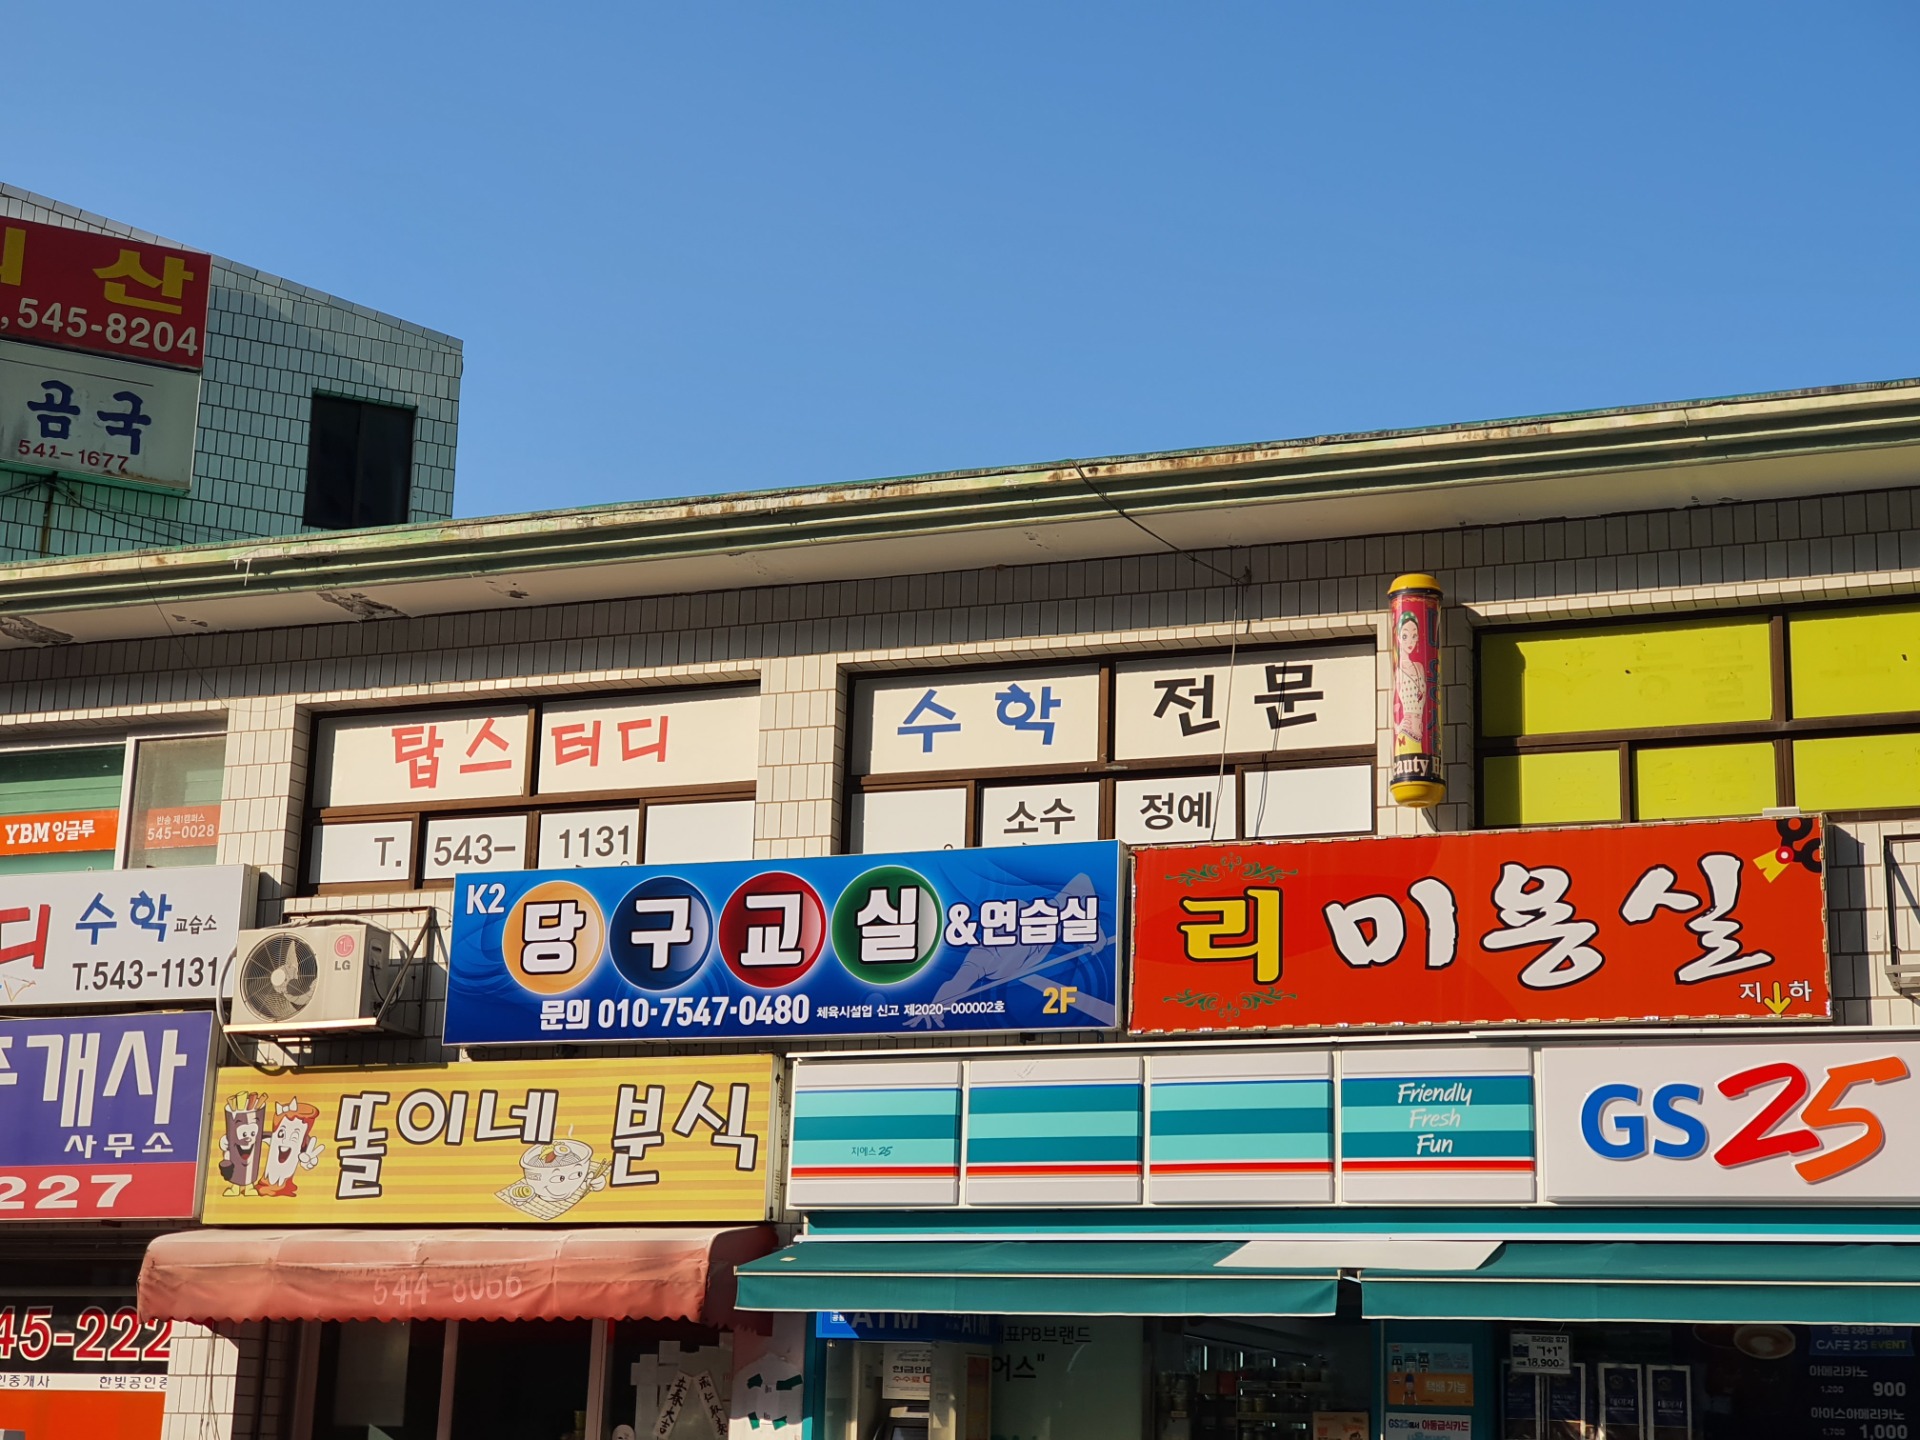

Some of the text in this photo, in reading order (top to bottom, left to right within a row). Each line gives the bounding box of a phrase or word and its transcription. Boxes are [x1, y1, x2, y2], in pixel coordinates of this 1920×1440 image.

[27, 379, 152, 455] 곰국
[897, 664, 1324, 754] 수학 전문
[156, 816, 172, 826] 반송
[1003, 790, 1212, 835] 소수 정예
[147, 824, 216, 841] 545-0028
[374, 836, 403, 868] T.
[558, 825, 631, 858] 1131
[466, 884, 505, 915] K2
[75, 890, 173, 946] 수학
[174, 915, 218, 935] 교습소
[335, 960, 351, 971] LG
[816, 1005, 873, 1019] 체육시설업
[877, 1004, 900, 1017] 신고
[1042, 986, 1078, 1014] 2F
[540, 999, 590, 1030] 문의
[1397, 1082, 1473, 1107] Friendly
[1408, 1107, 1461, 1130] Fresh
[1580, 1055, 1910, 1184] GS25
[64, 1132, 174, 1159] 사무소
[336, 1080, 759, 1200] 똘이네 분식
[1416, 1135, 1454, 1156] Fun
[998, 1325, 1093, 1345] 표PB브랜드
[1870, 1340, 1906, 1350] EVENT
[1809, 1365, 1868, 1377] 아메리카노
[1872, 1381, 1906, 1397] 900
[1810, 1407, 1905, 1420] 아이스아메리카노
[1859, 1423, 1908, 1440] 1,000
